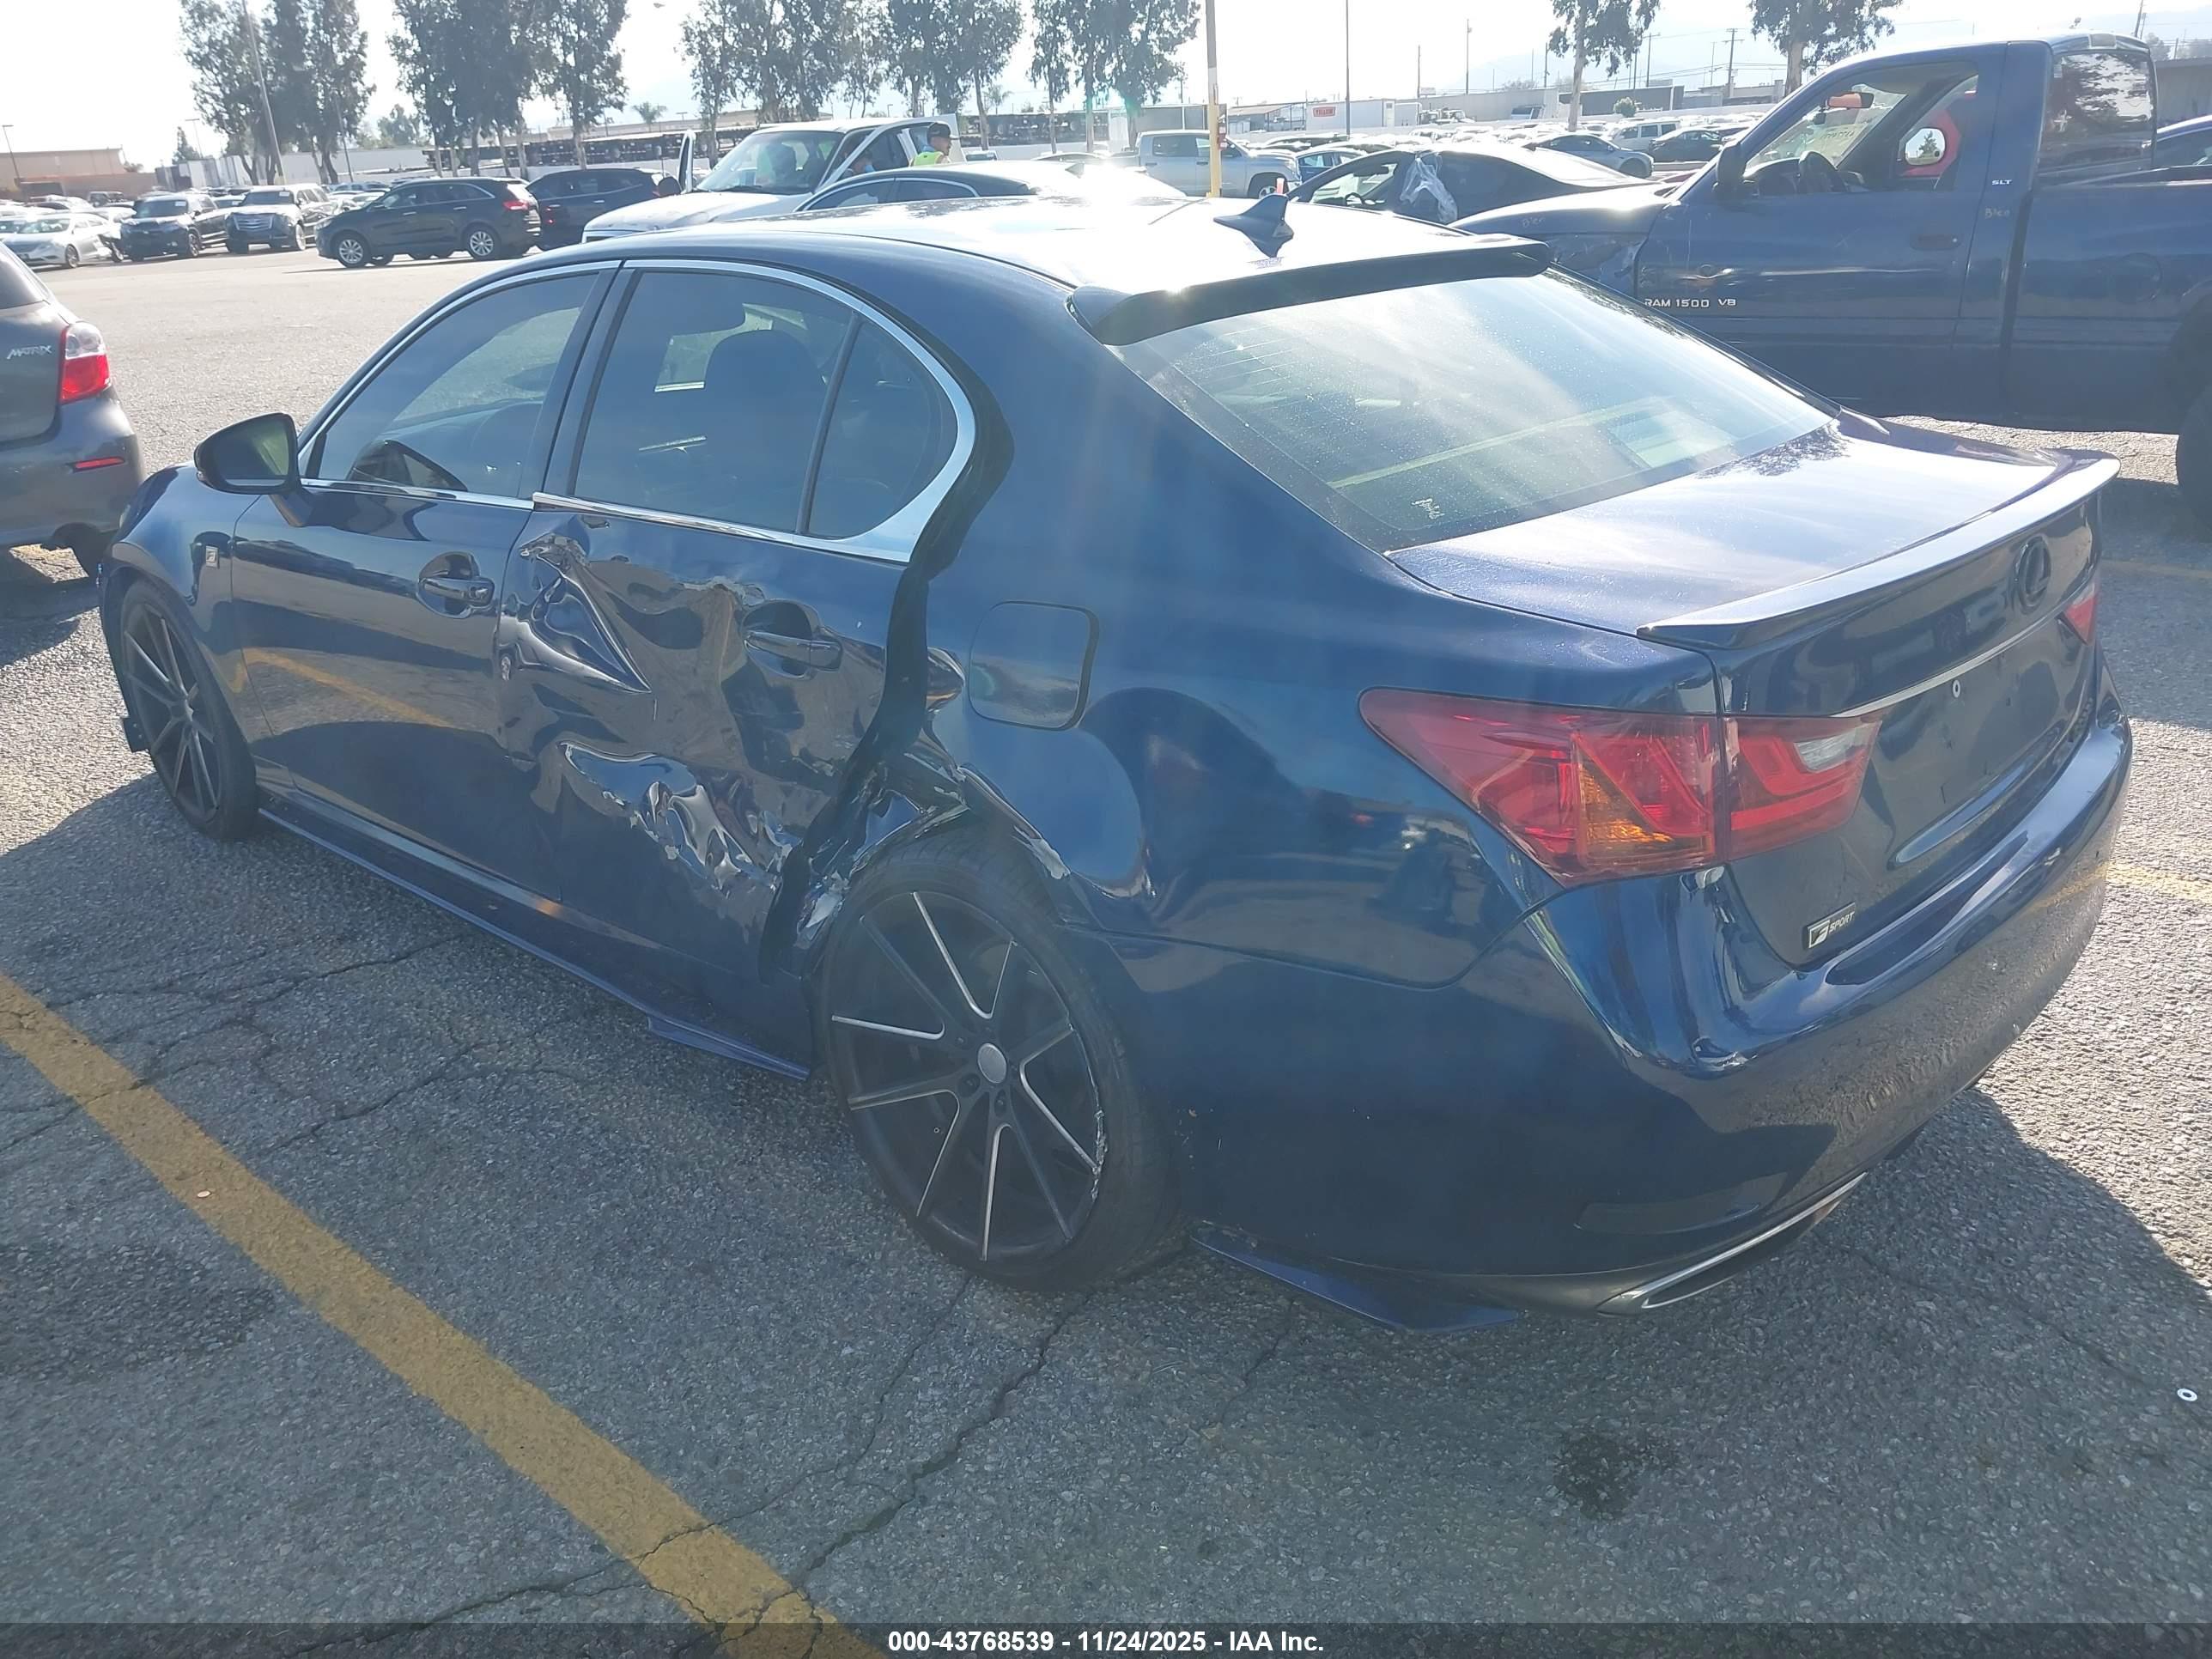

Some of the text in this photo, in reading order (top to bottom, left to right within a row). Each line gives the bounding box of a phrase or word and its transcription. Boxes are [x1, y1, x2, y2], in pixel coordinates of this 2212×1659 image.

[1644, 298, 1670, 307] RAM
[1675, 298, 1710, 307] 1500
[6, 345, 52, 359] MATRIX
[1828, 911, 1856, 933] SPORT
